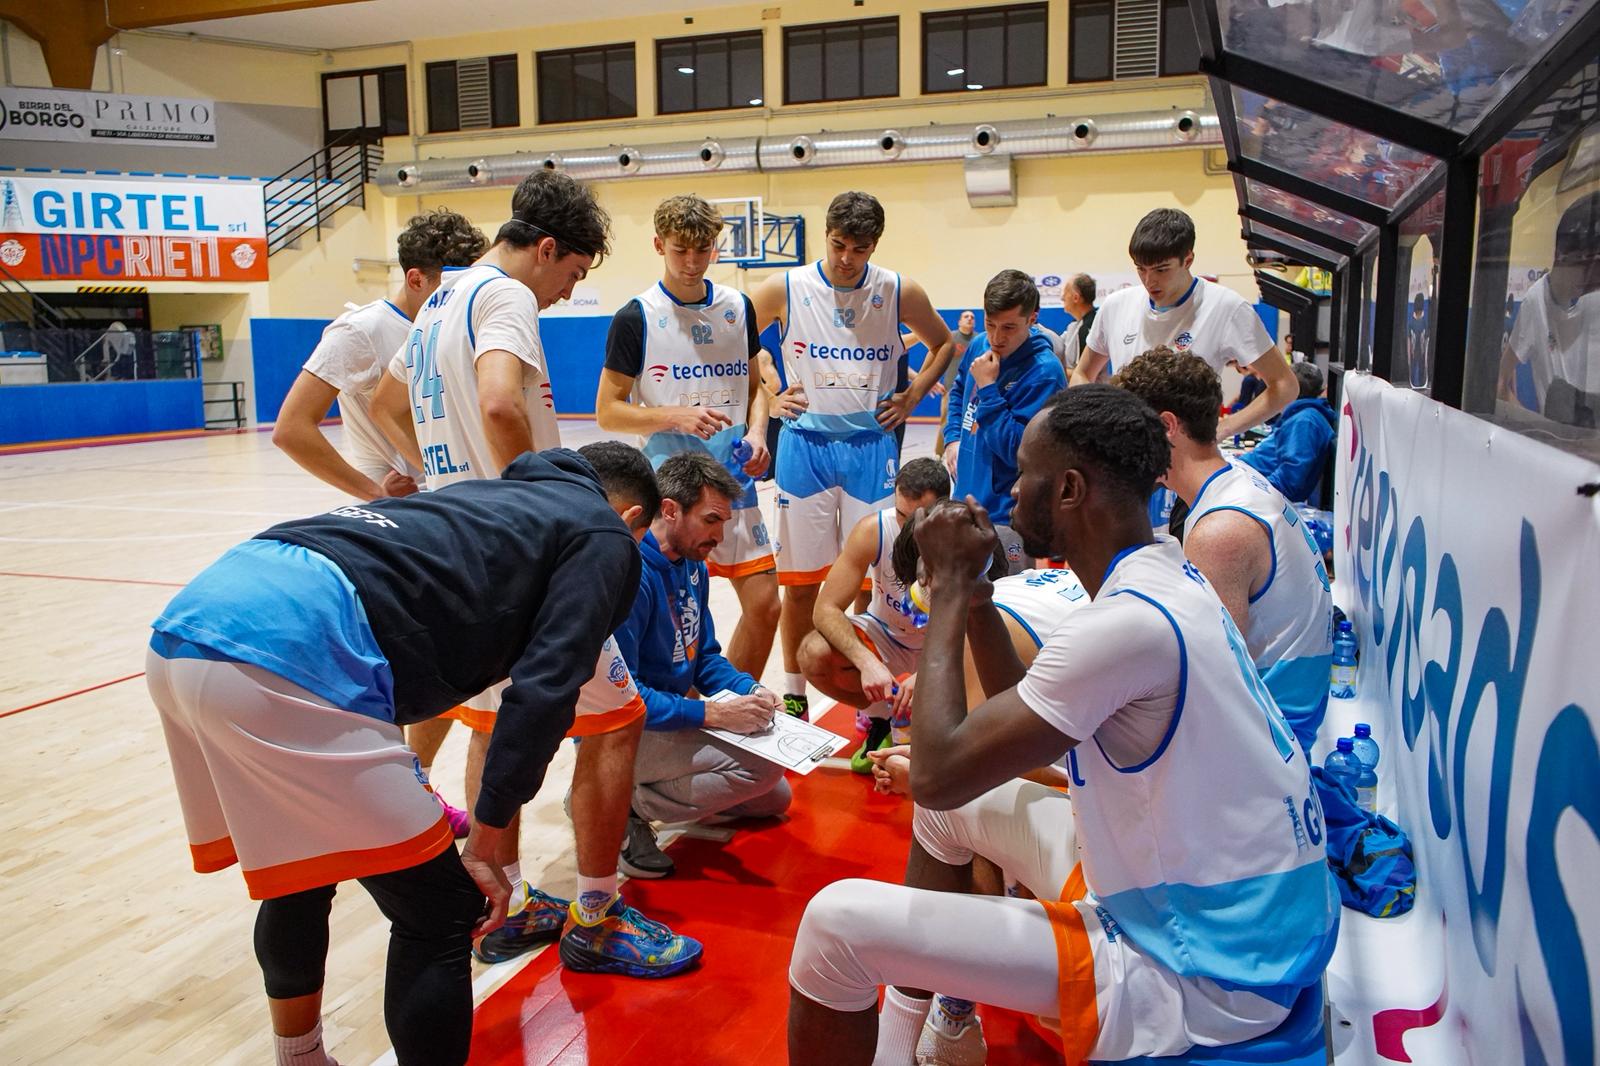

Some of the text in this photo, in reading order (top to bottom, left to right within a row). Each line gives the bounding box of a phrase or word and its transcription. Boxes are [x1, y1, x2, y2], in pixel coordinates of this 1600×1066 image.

[19, 101, 74, 112] BIRRA DEL
[95, 99, 209, 124] PRIMO
[9, 110, 85, 129] BORGO
[32, 190, 247, 232] GIRTEL srl
[573, 298, 598, 306] ROMA
[833, 308, 855, 328] 52
[406, 319, 446, 425] 24
[672, 359, 748, 380] tecnoads
[672, 629, 686, 663] NPC
